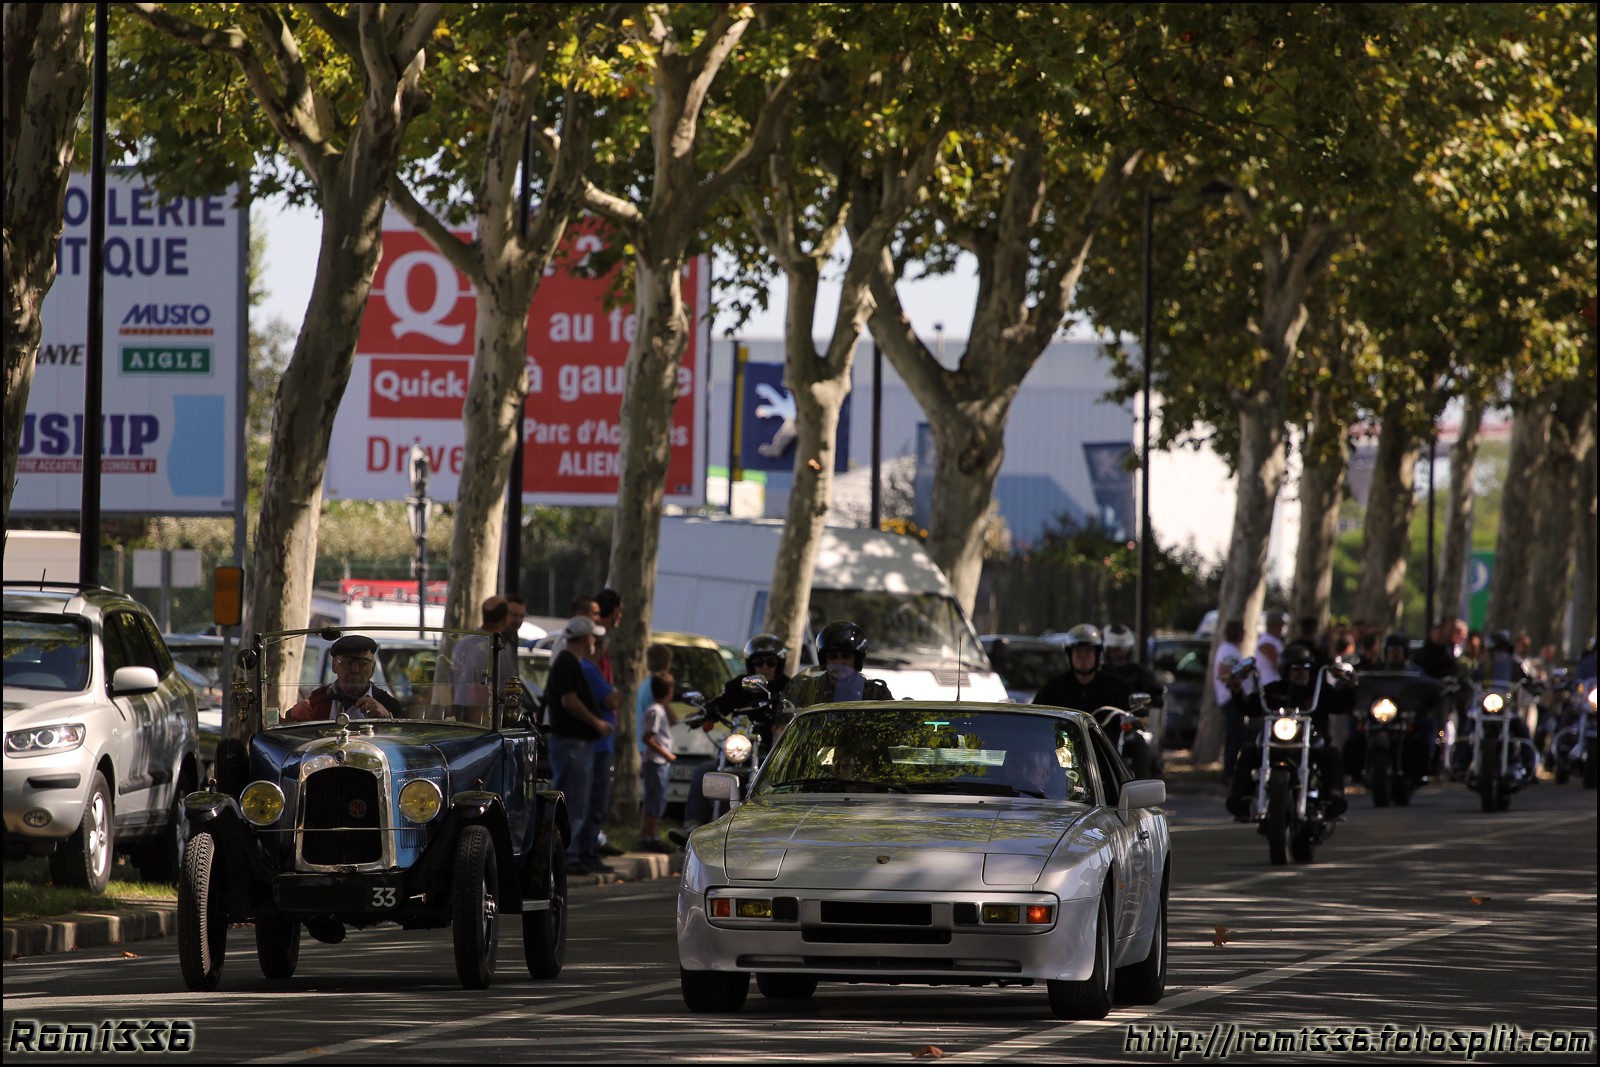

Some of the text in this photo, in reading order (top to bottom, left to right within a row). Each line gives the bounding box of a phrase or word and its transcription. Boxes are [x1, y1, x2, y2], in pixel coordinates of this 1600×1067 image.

[384, 250, 466, 345] Q
[121, 304, 212, 325] MUSTO
[549, 312, 594, 342] au
[129, 351, 204, 369] AIGLE
[374, 369, 465, 402] Quick
[526, 355, 692, 402] à gaue
[523, 418, 570, 445] Parc
[367, 436, 463, 474] Drve
[372, 887, 397, 907] 33
